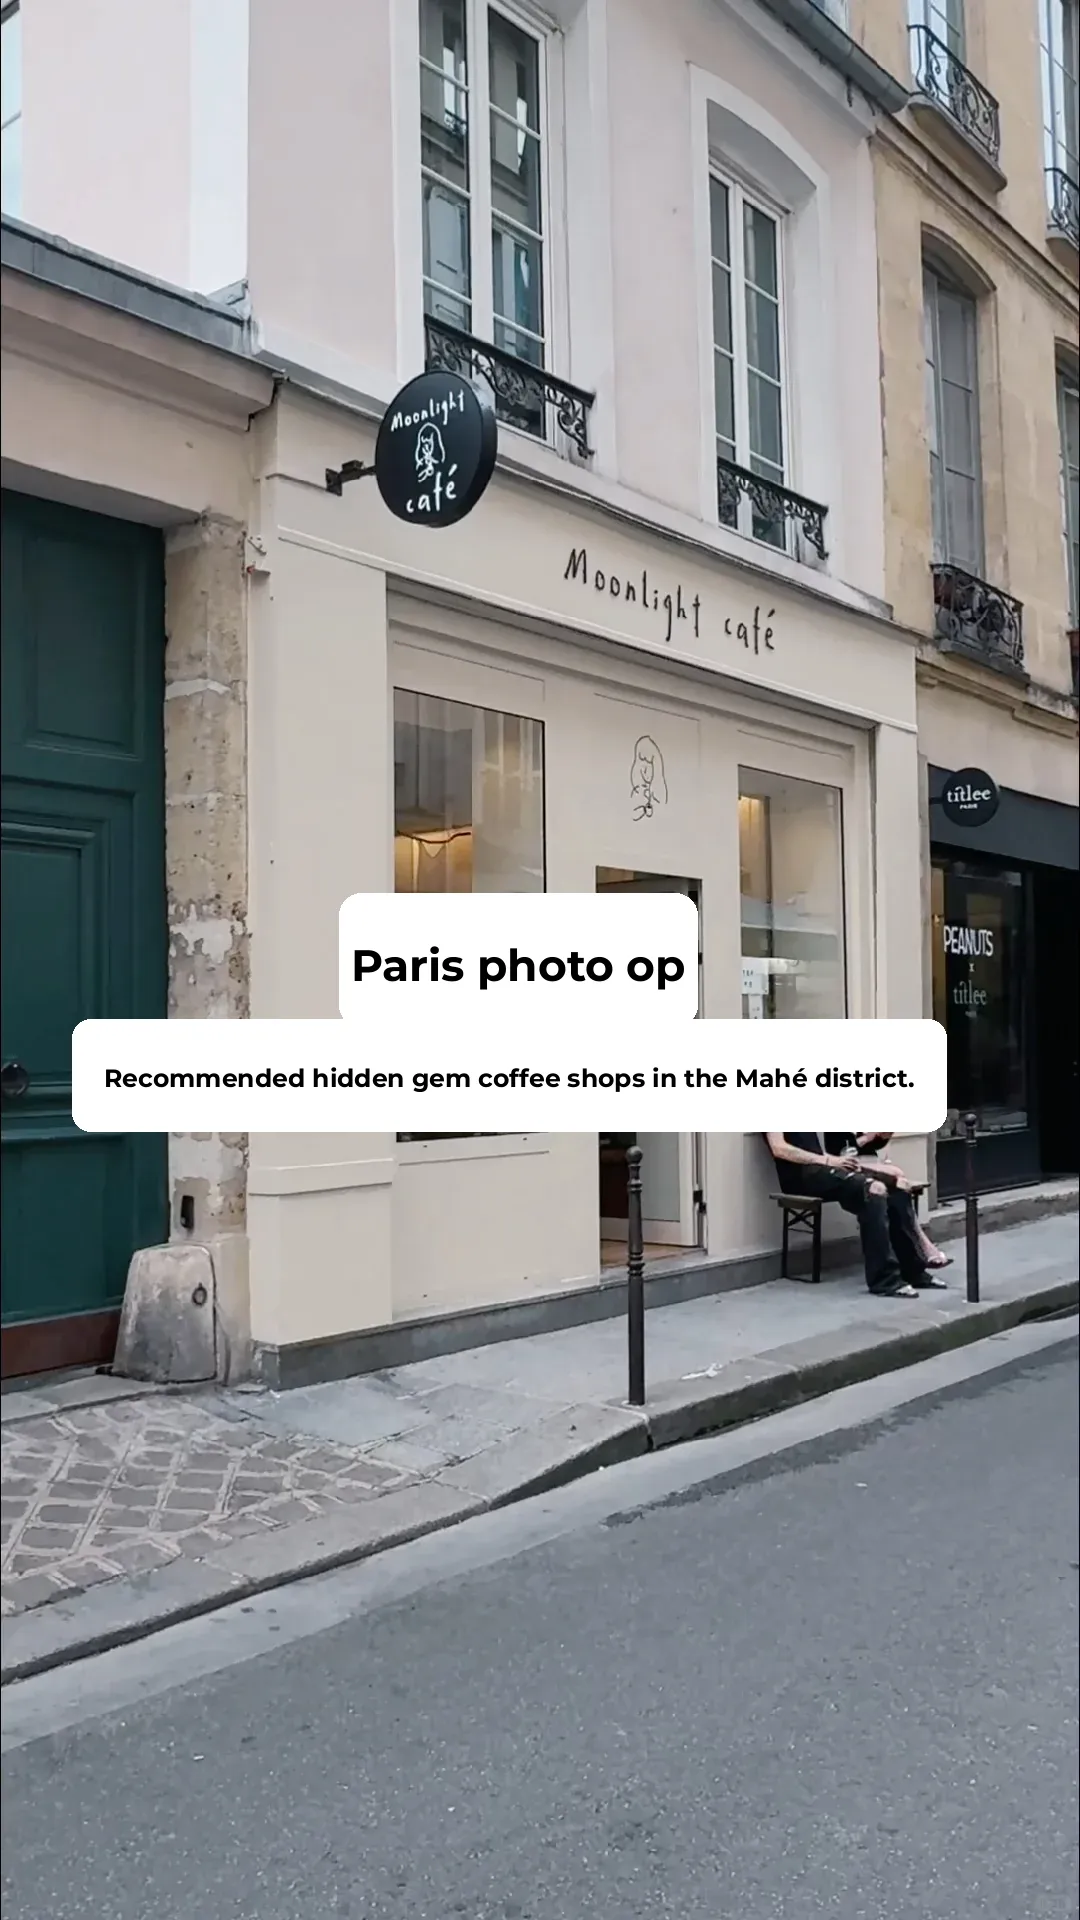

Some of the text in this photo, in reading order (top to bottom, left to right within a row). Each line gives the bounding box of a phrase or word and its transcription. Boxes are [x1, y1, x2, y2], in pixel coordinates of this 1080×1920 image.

[390, 389, 464, 432] Moonlight
[406, 463, 457, 513] café
[563, 548, 776, 655] Moonlight café
[943, 925, 994, 957] PEANUTS
